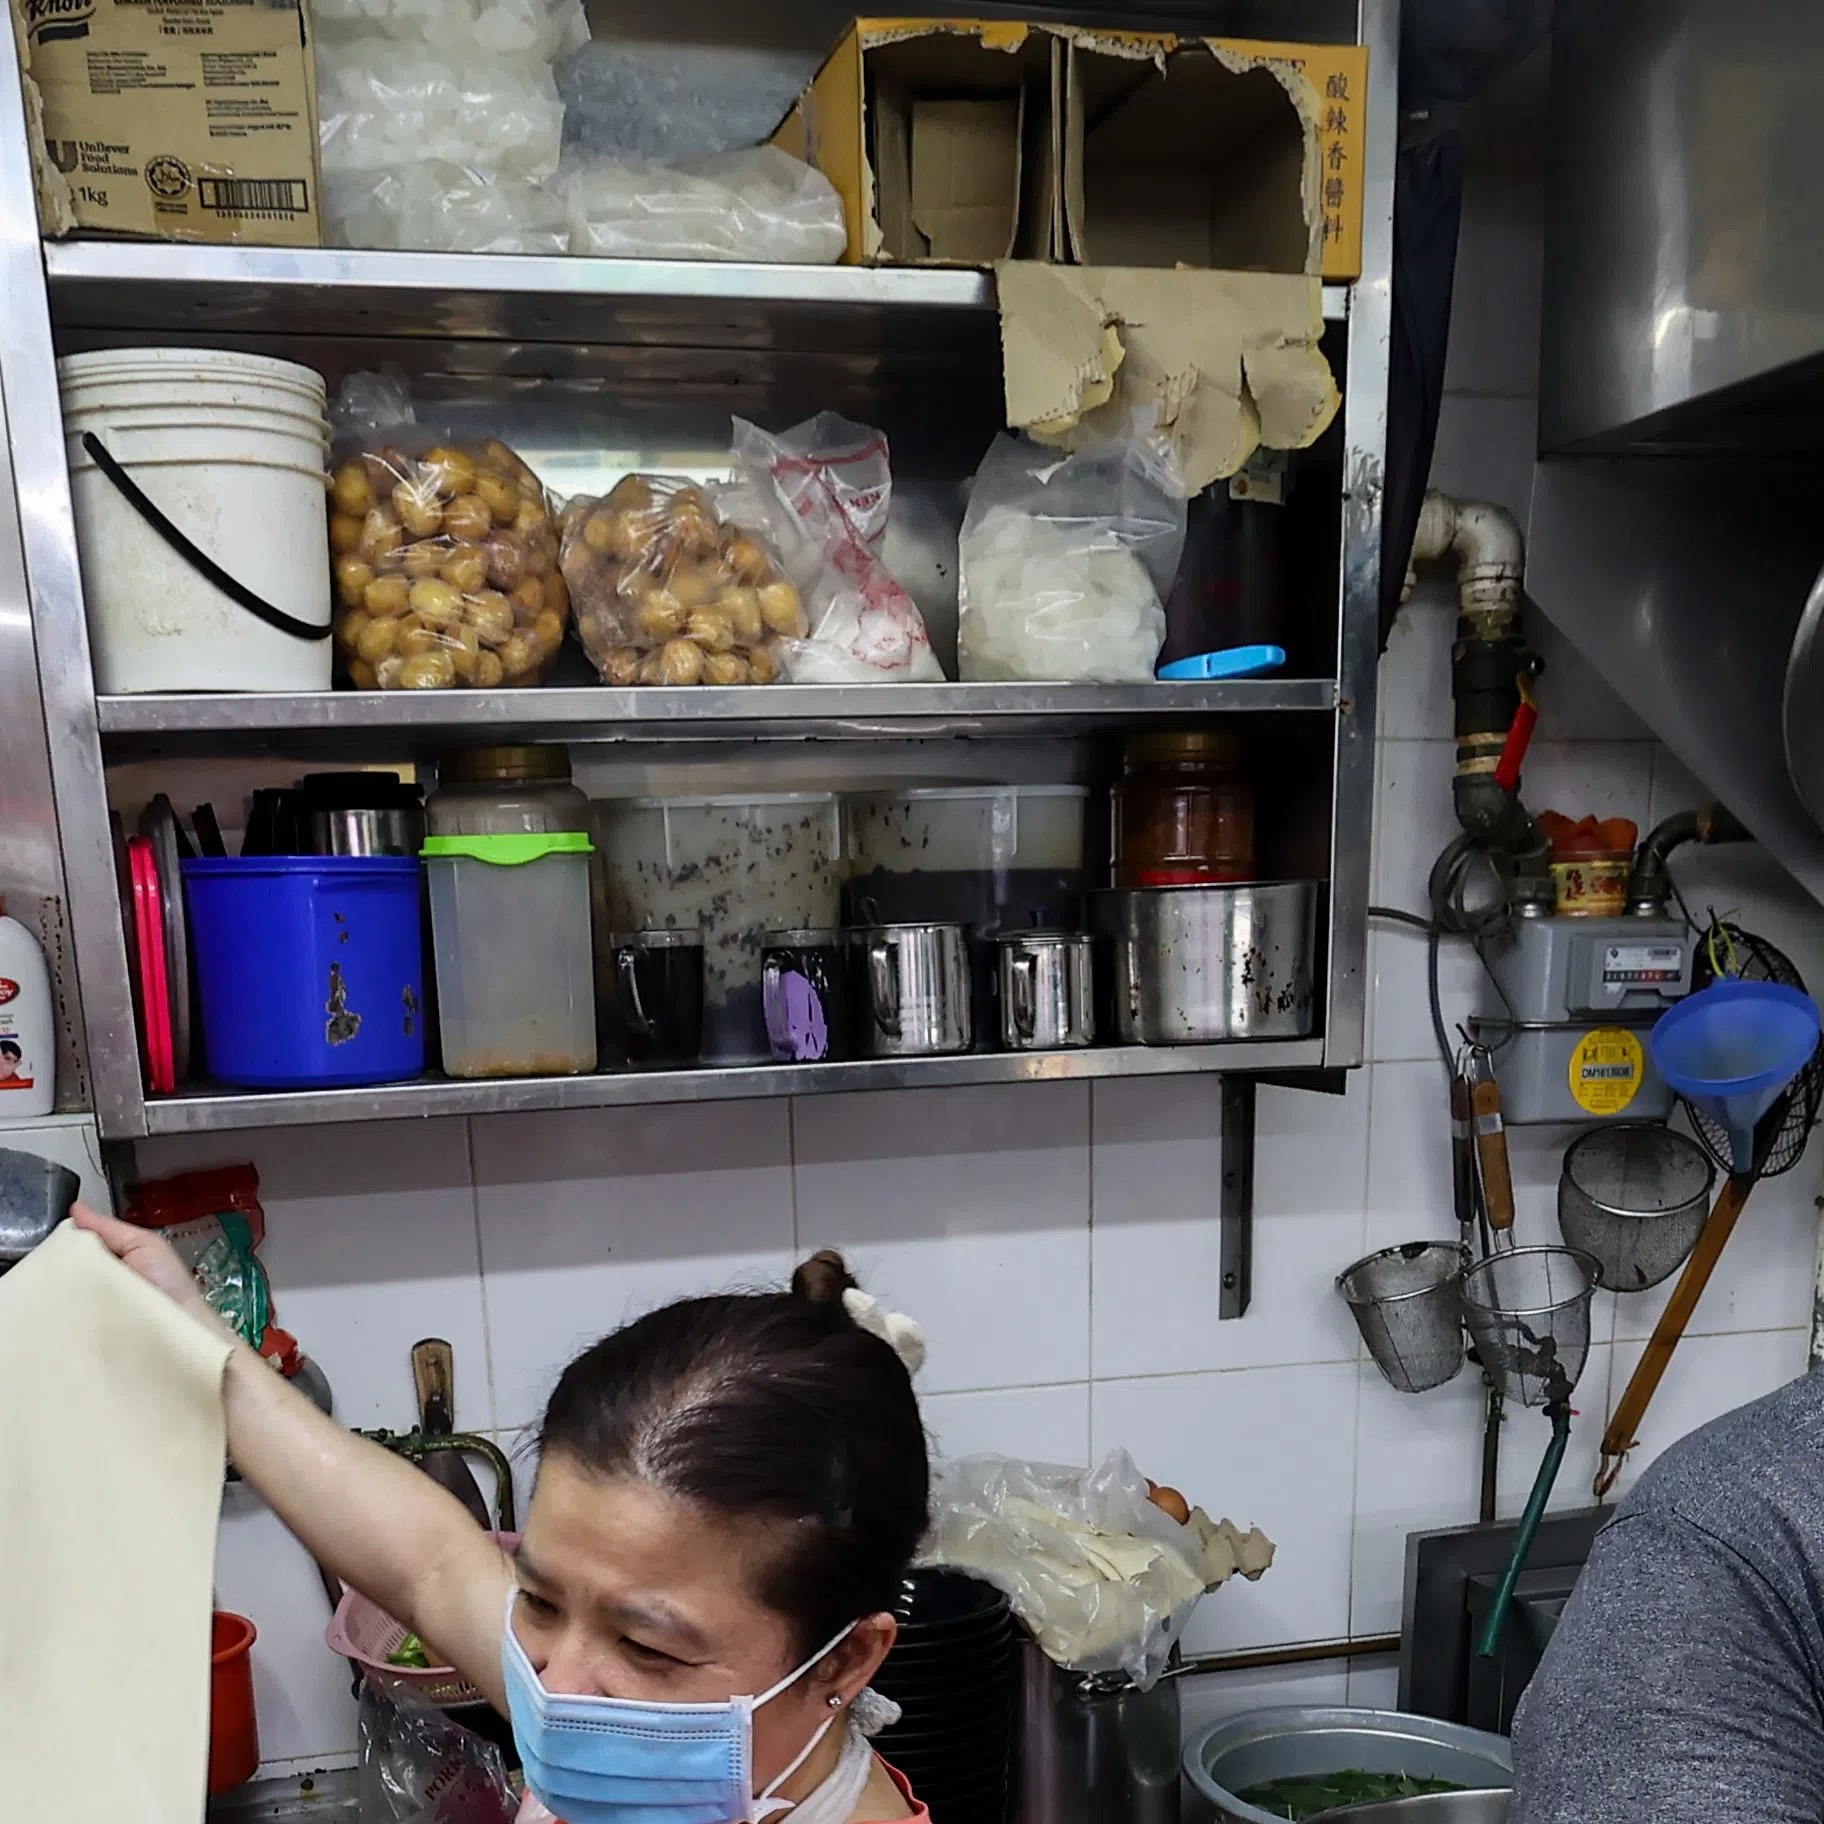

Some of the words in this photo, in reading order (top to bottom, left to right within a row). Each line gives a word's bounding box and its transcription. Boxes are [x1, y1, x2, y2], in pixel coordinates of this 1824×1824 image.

[79, 141, 130, 154] Unilever
[81, 152, 109, 163] Food
[82, 162, 138, 177] Solutions
[79, 186, 109, 207] 1kg
